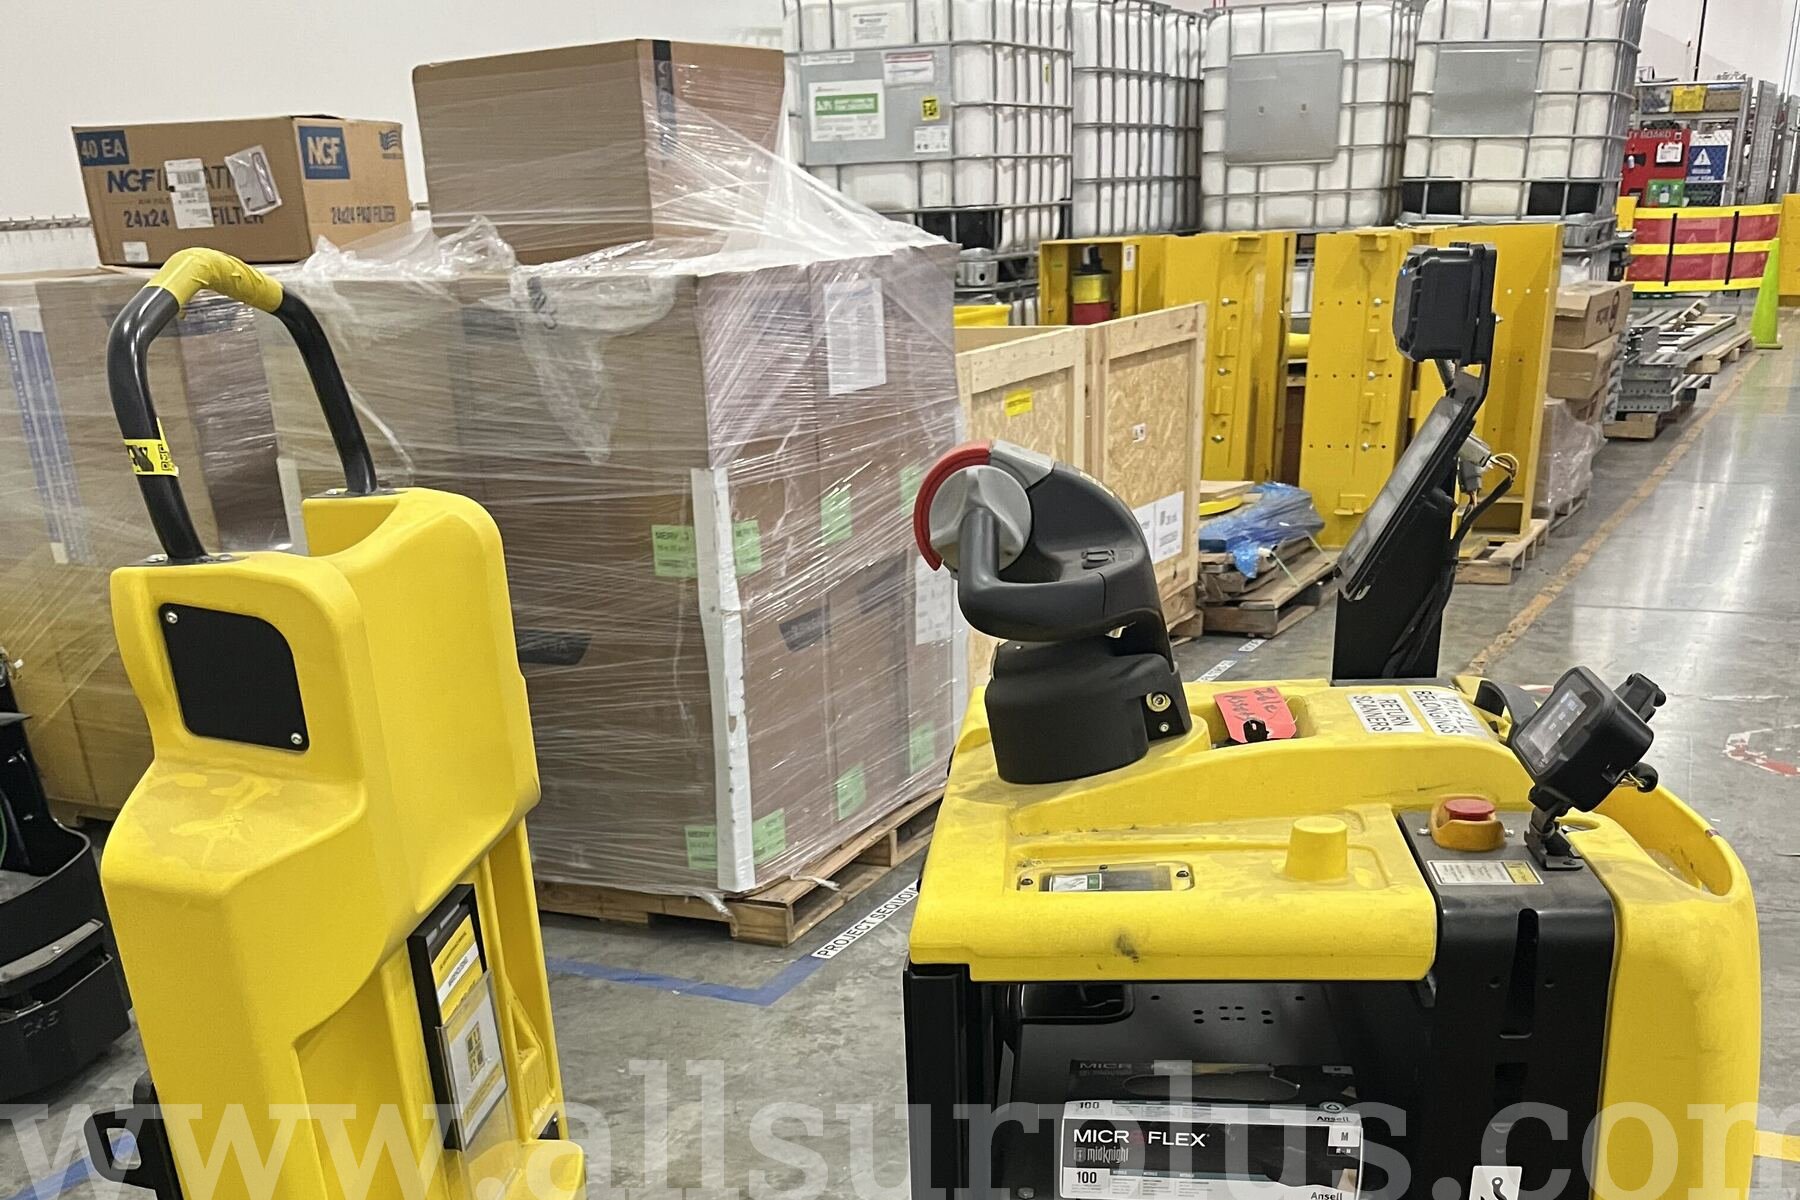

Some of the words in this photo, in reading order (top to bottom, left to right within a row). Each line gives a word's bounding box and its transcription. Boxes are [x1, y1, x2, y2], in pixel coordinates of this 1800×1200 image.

[81, 139, 98, 158] 40
[101, 138, 126, 158] EA
[124, 208, 169, 228] 24x24
[1353, 695, 1393, 732] SCANNERS
[1377, 699, 1415, 726] RETURN
[1413, 691, 1461, 733] BELONGINGS
[817, 920, 877, 957] PROJECT
[1340, 1131, 1349, 1142] M
[1087, 1146, 1129, 1164] midknight
[1076, 1171, 1097, 1184] 100
[1310, 1191, 1343, 1200] Ansell
